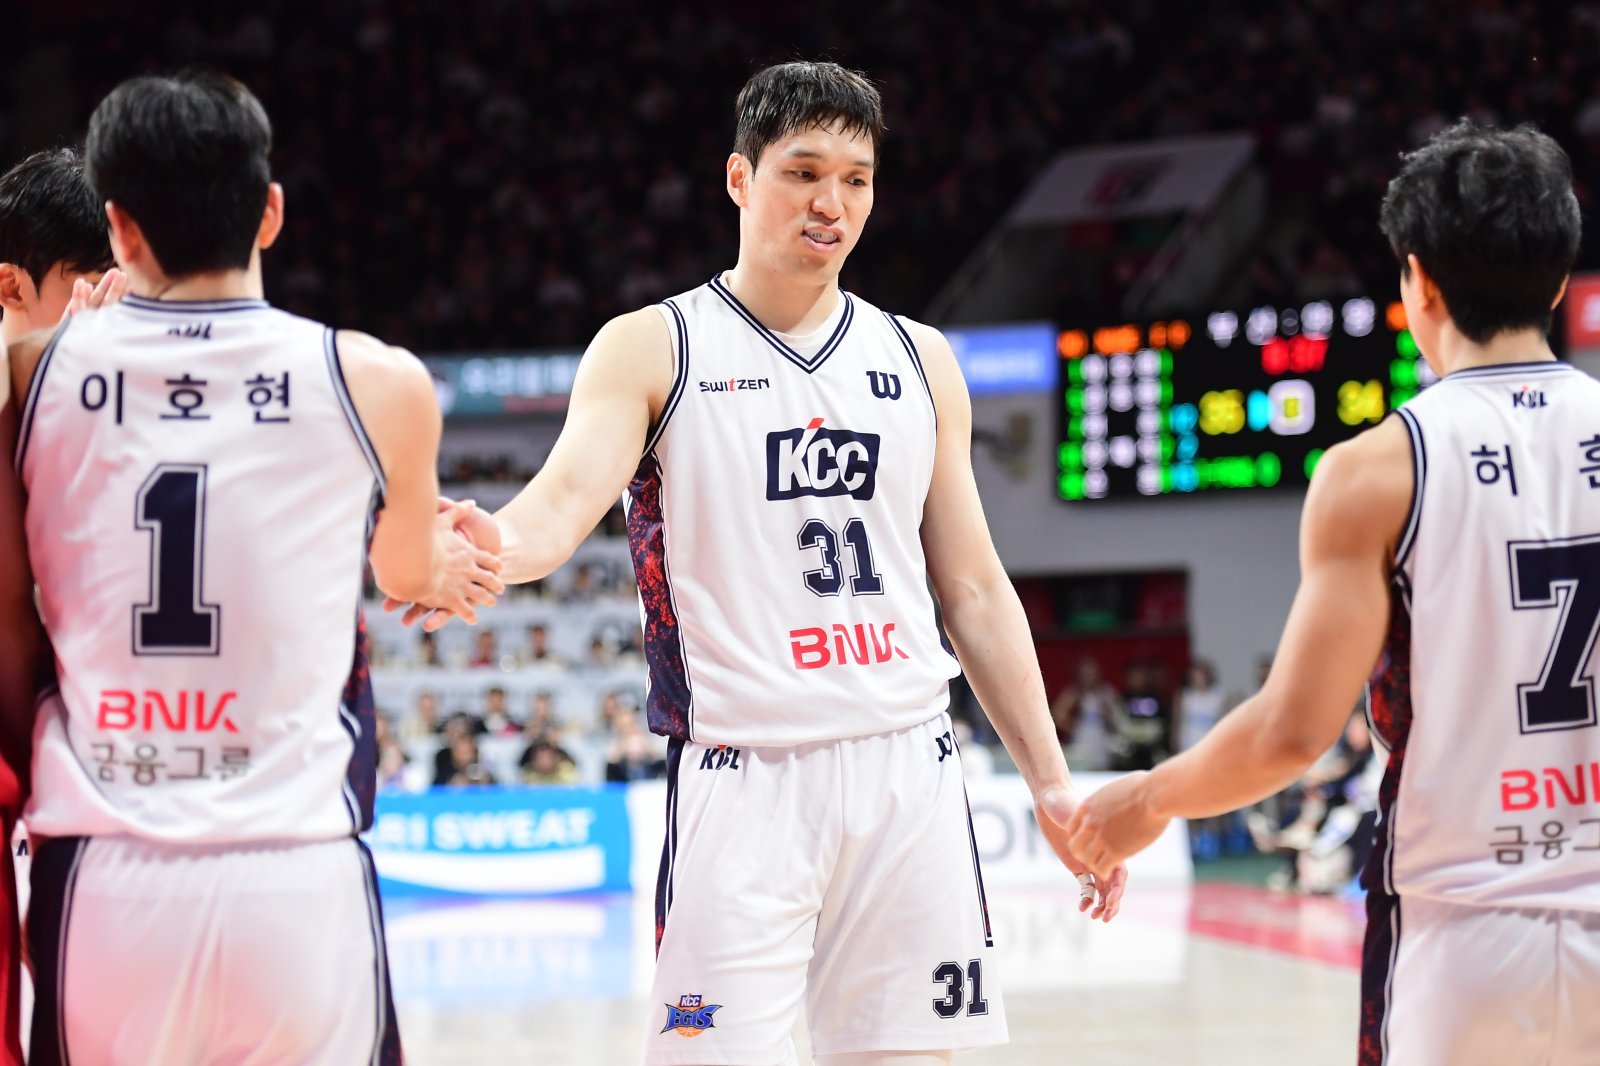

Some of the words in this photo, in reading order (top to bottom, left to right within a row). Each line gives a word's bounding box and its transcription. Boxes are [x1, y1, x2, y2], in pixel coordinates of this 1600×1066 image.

[776, 418, 870, 493] KCC
[132, 462, 220, 656] 1
[797, 518, 884, 597] 31
[789, 622, 910, 670] BNK
[1507, 533, 1600, 734] 7
[98, 689, 239, 734] BNK
[699, 744, 741, 771] KBL
[432, 807, 596, 851] SWEAT
[680, 994, 702, 1007] KCC
[932, 958, 988, 1019] 31
[660, 1003, 724, 1034] EGIS
